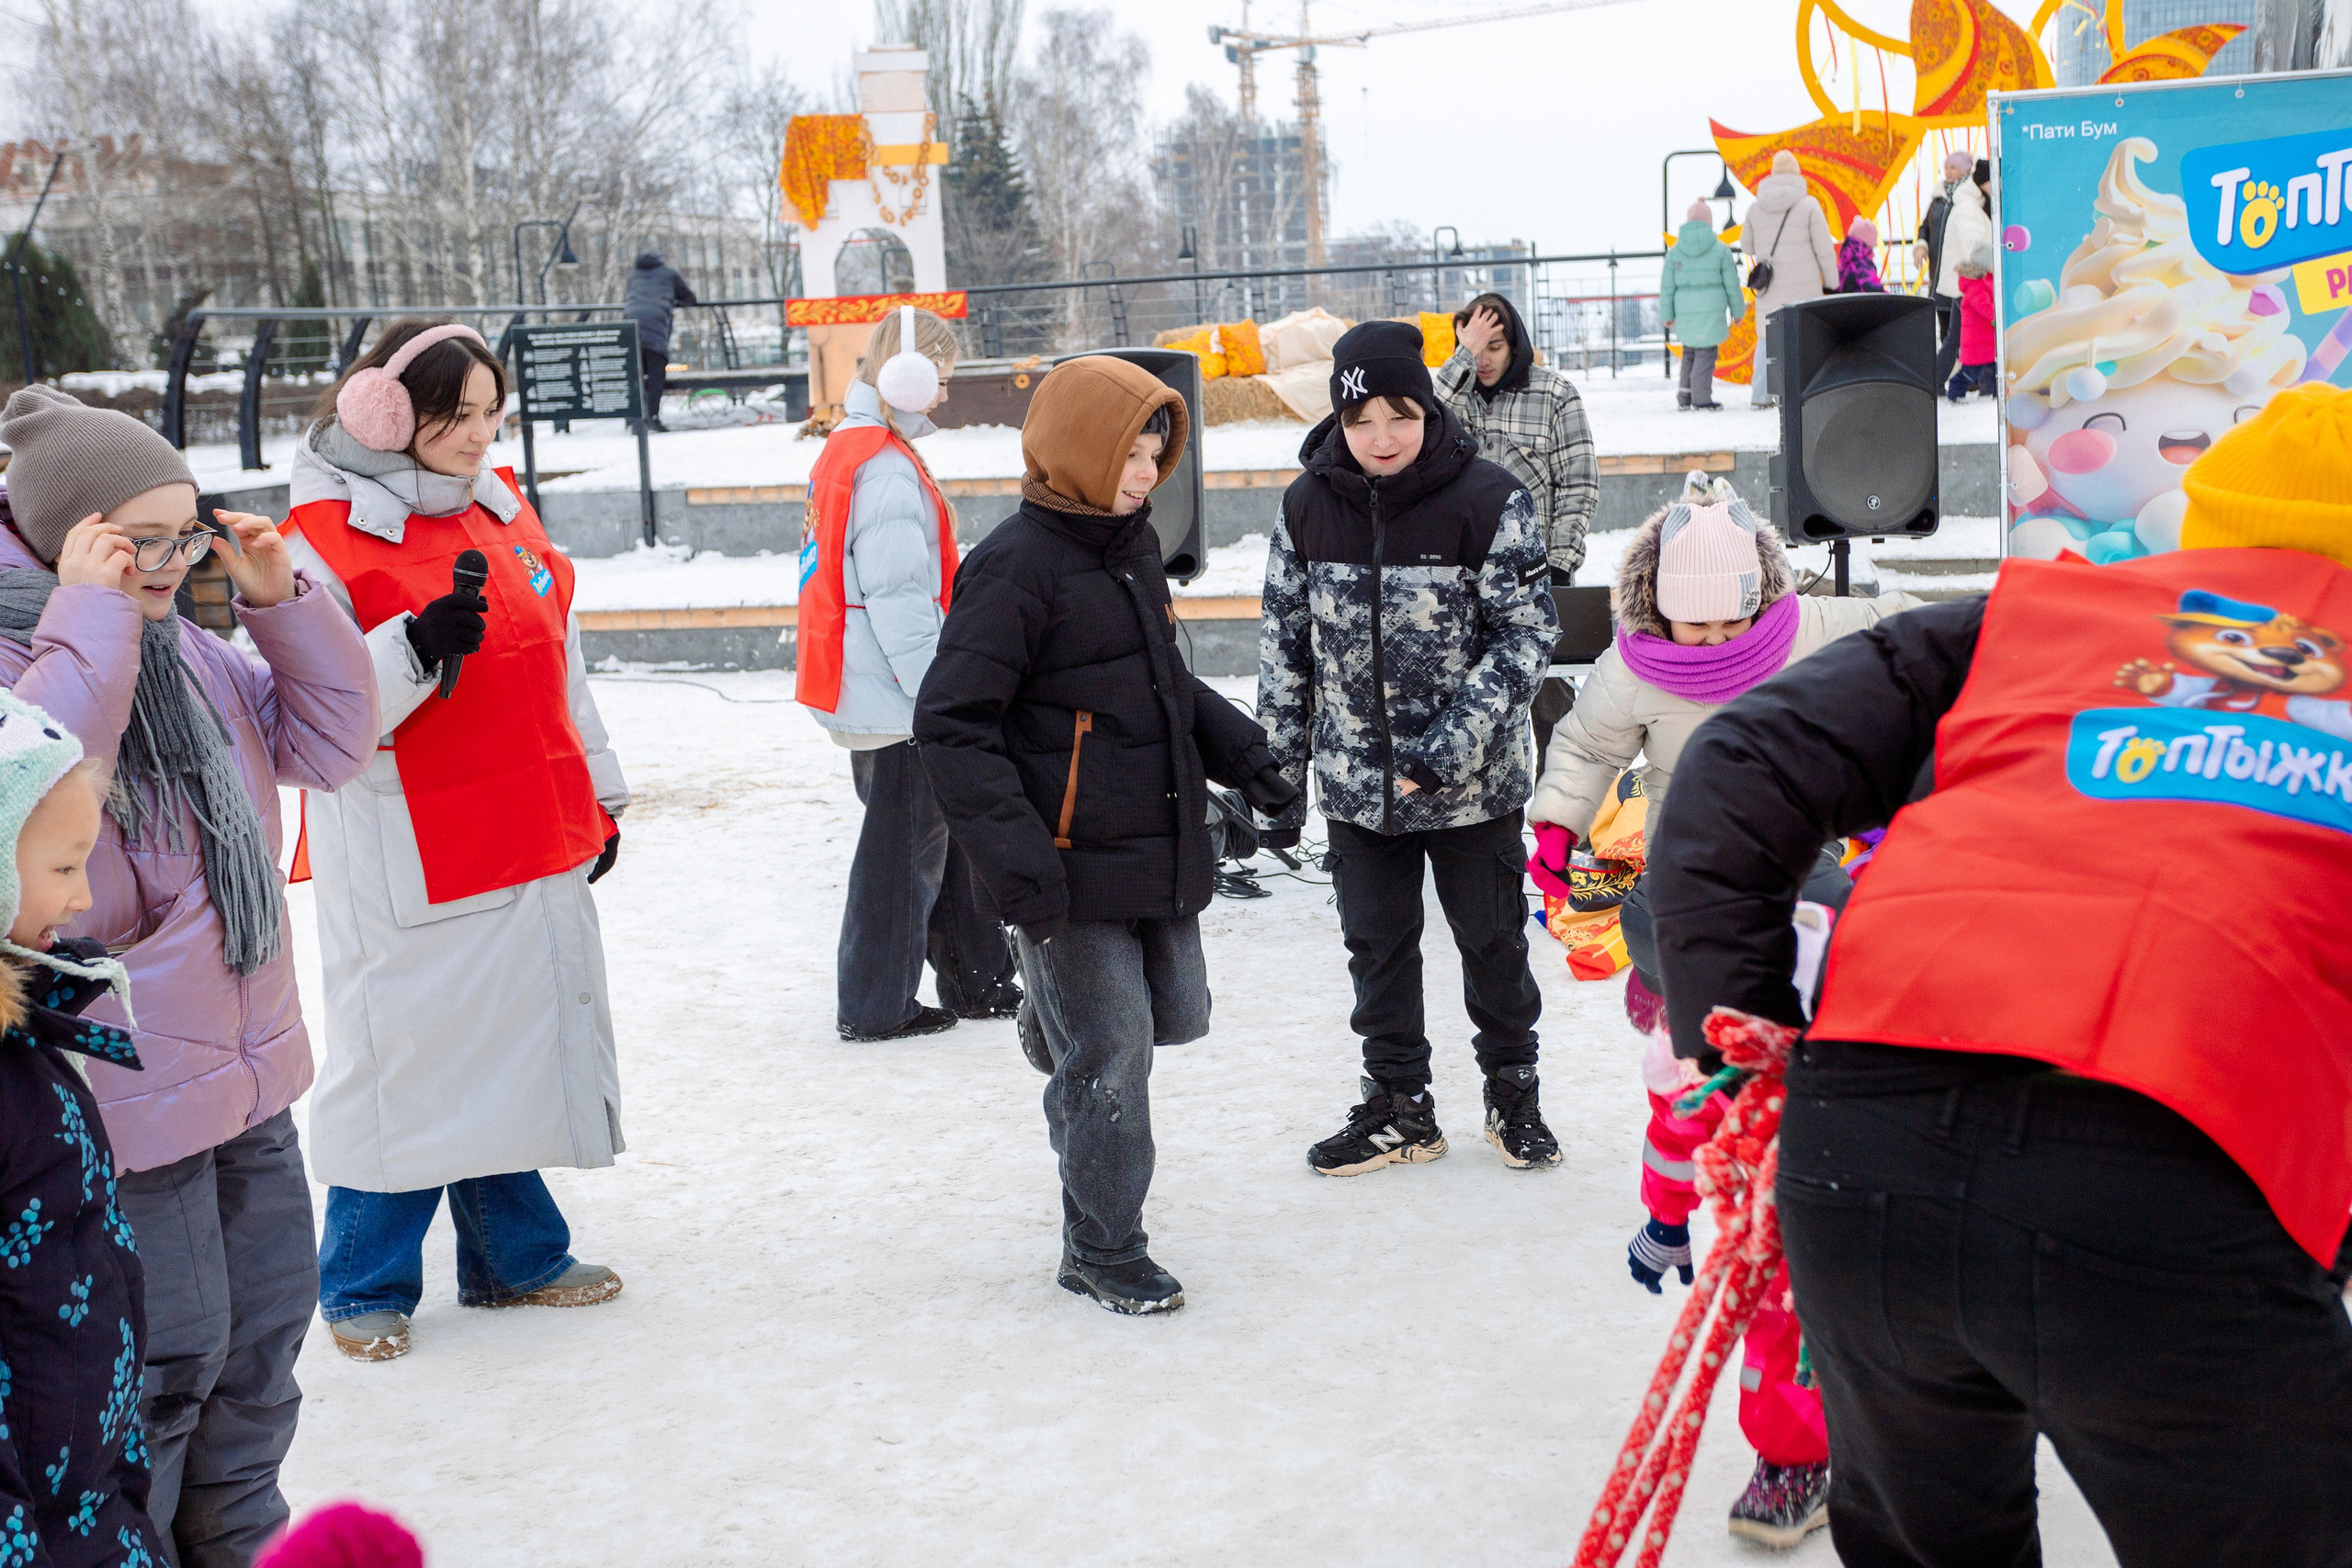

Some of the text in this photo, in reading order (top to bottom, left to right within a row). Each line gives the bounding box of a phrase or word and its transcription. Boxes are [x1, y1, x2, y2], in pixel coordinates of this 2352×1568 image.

[2080, 120, 2118, 139] Бум
[1340, 366, 1368, 400] NY
[1368, 1124, 1406, 1153] N
